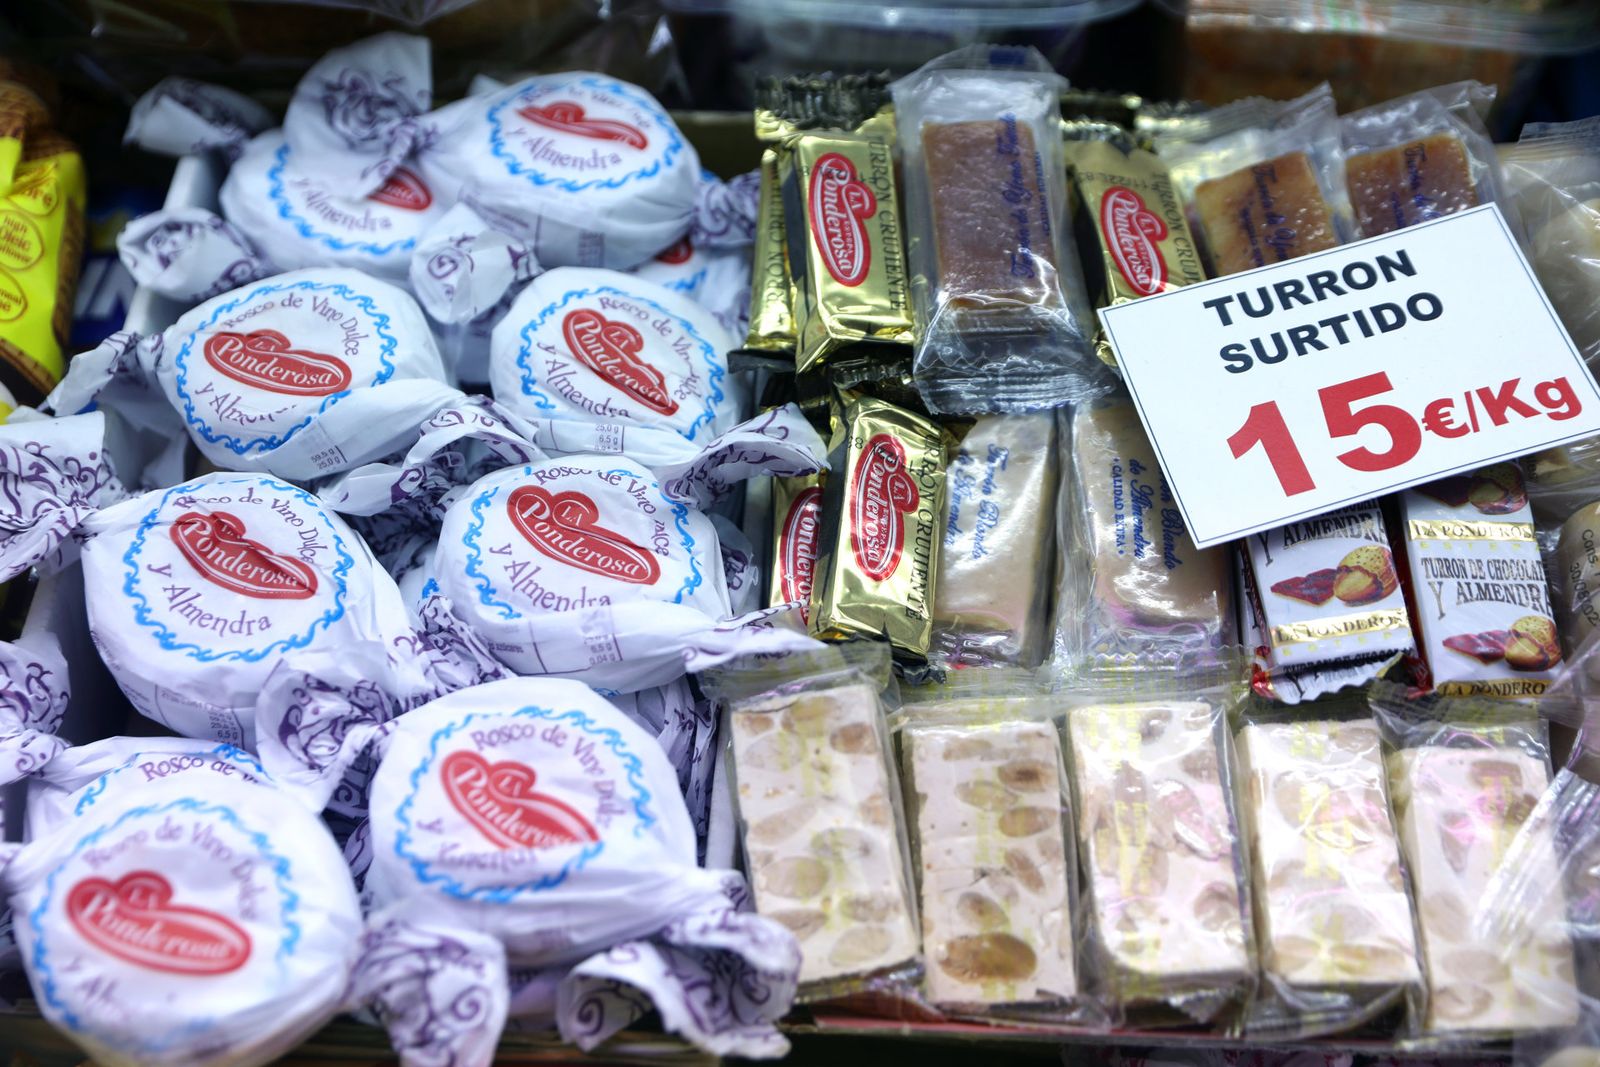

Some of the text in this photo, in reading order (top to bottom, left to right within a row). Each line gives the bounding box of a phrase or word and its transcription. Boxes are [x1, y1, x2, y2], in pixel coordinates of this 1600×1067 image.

[522, 134, 623, 173] Almendra
[303, 188, 392, 233] Almendra
[821, 164, 853, 271] Ponderosa
[1113, 197, 1151, 285] Ponderosa
[878, 209, 909, 312] CRUJIENTE
[1173, 236, 1201, 286] CRUJI
[1202, 248, 1418, 327] TURRON
[220, 292, 370, 357] Rosco de Vino Dulce
[609, 330, 630, 350] LA
[651, 318, 673, 337] de
[1218, 291, 1445, 375] SURTIDO
[194, 381, 214, 396] y
[216, 338, 334, 385] Ponderosa
[536, 341, 631, 419] y Almendra
[573, 319, 663, 404] Ponderosa
[1226, 370, 1584, 498] 15€/Kg
[561, 505, 584, 527] LA
[626, 479, 657, 515] Vino
[653, 519, 671, 557] ulce
[865, 447, 900, 563] Ponderosa
[893, 480, 905, 501] LA
[1112, 464, 1126, 551] CALIDAD EXTRA
[1129, 458, 1154, 560] de Almendra
[183, 521, 300, 589] Ponderosa
[238, 487, 264, 505] de
[270, 497, 305, 528] Vino
[297, 527, 329, 564] Dulce
[522, 501, 641, 577] Ponderosa
[972, 499, 1000, 560] Blando
[1160, 508, 1185, 570] Blando
[1257, 530, 1274, 567] Y
[1414, 524, 1438, 538] LA
[1581, 529, 1599, 567] Cons.
[489, 543, 612, 613] y Almendra
[906, 508, 935, 621] CRUJIENTE
[1421, 556, 1546, 582] TURRON DE CHOCOLAT
[147, 562, 273, 637] y Almendra
[1307, 609, 1405, 637] PONDEROS
[1427, 580, 1447, 621] Y
[1442, 681, 1547, 697] LA PONDERO
[139, 755, 205, 782] Rosco
[470, 724, 536, 751] Rosco
[541, 724, 568, 748] de
[154, 815, 184, 842] de
[81, 888, 234, 959] Ponderosa
